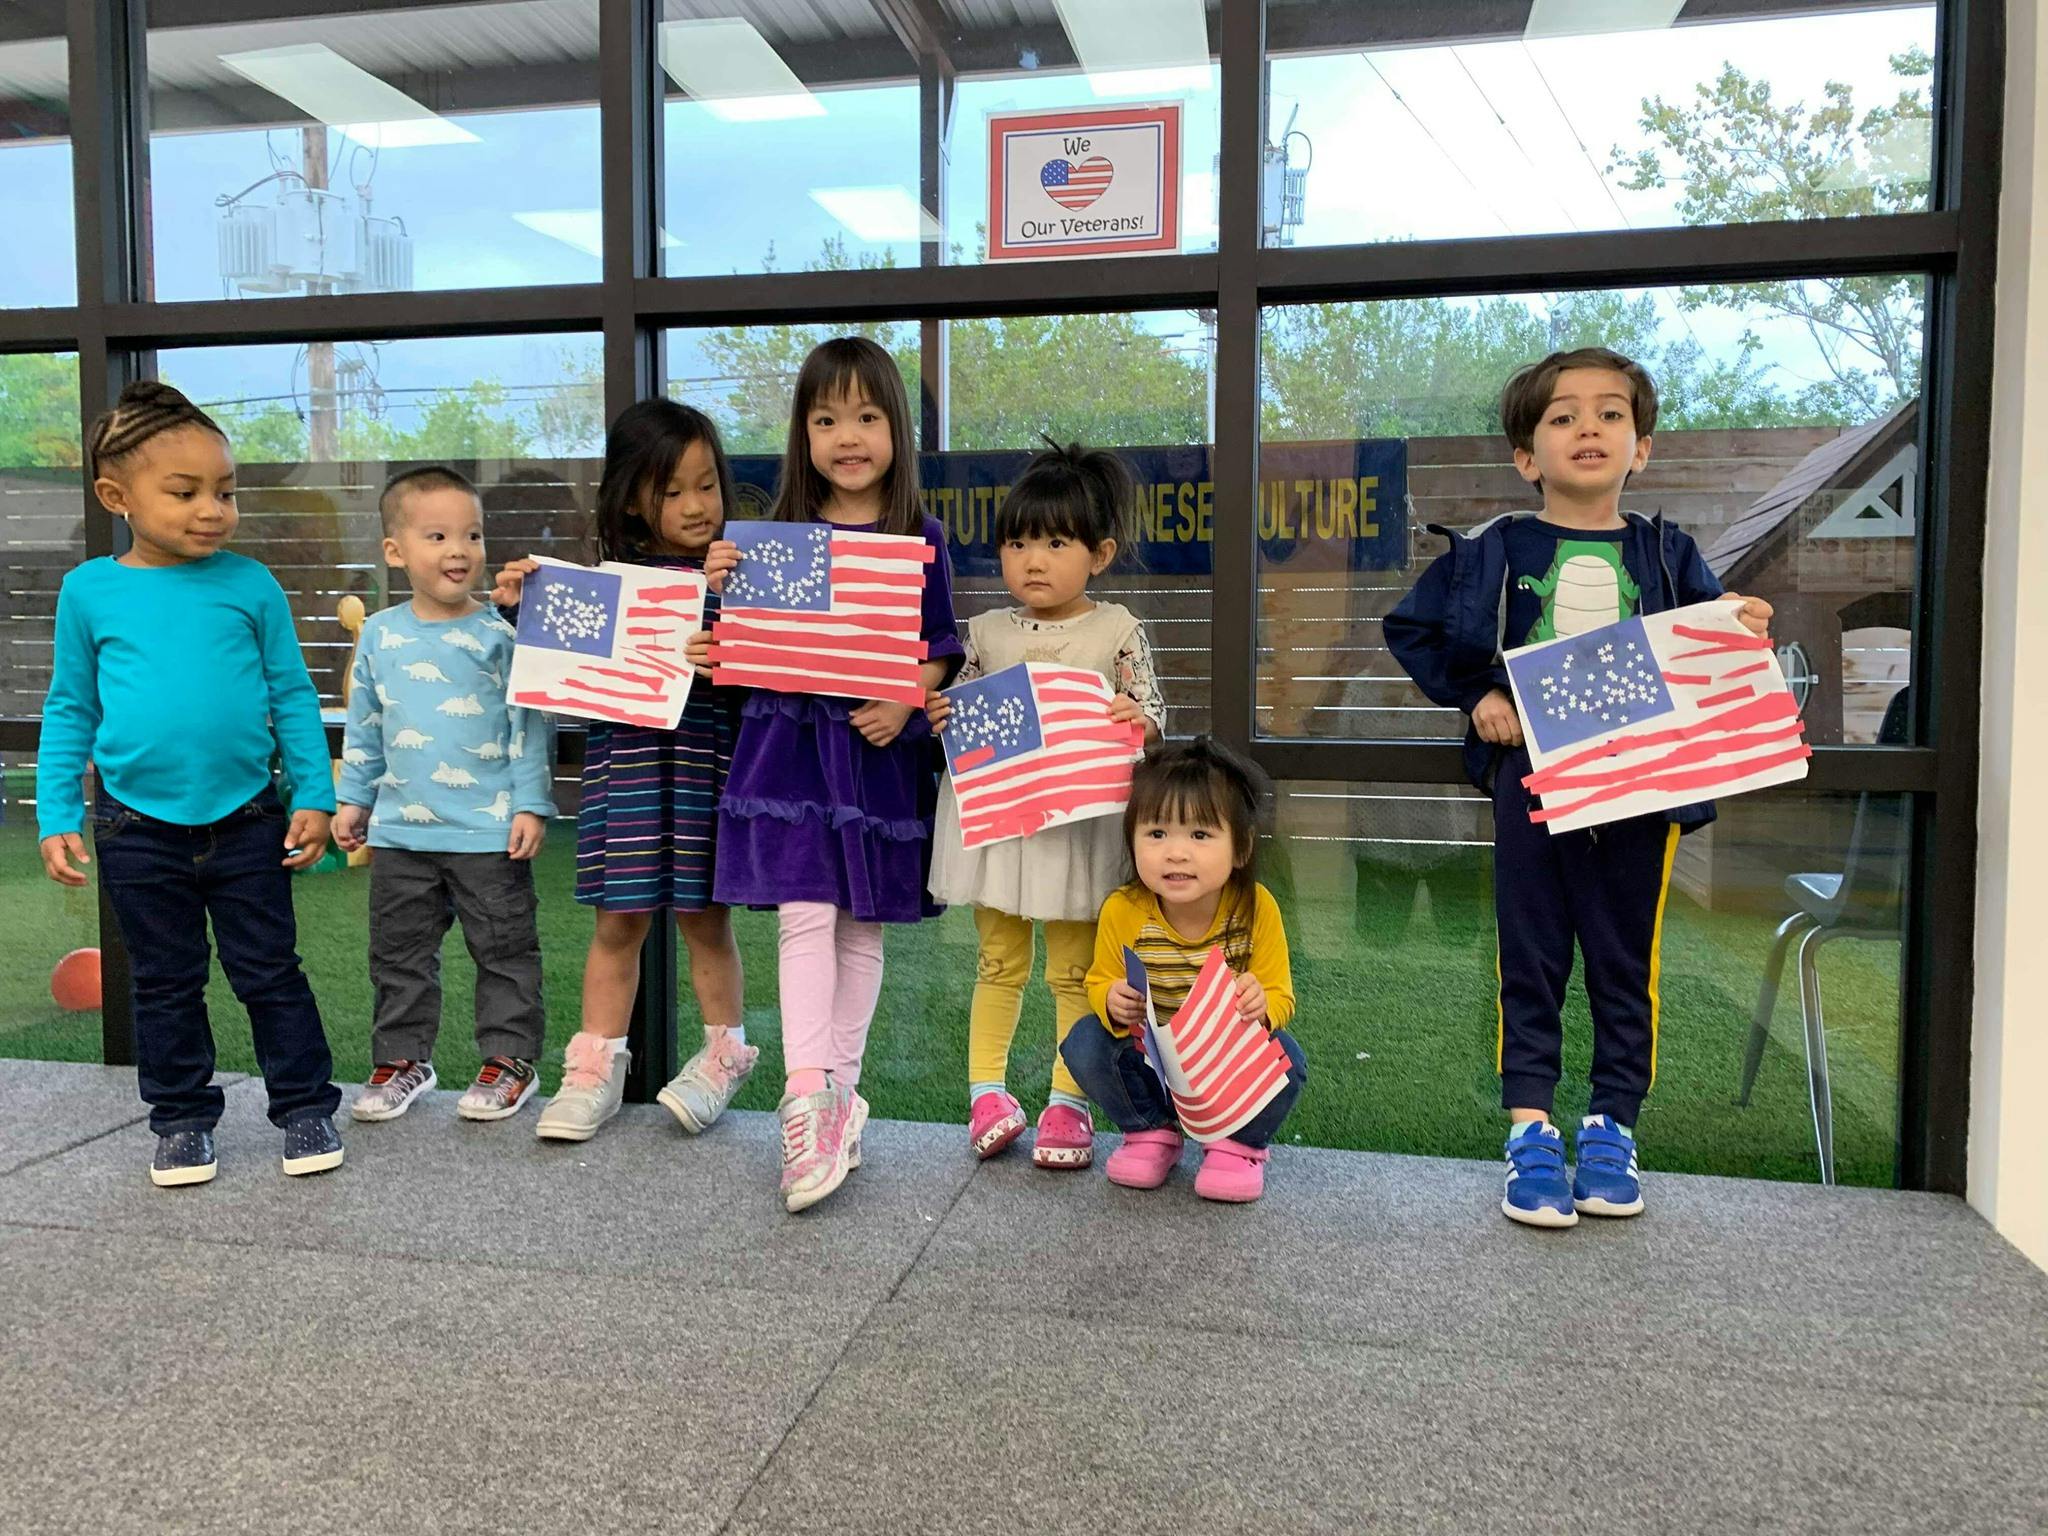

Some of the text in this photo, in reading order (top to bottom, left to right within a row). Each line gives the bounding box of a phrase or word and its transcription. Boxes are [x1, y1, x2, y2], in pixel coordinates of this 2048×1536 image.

[1063, 136, 1091, 156] We
[1021, 215, 1144, 239] Our Veterans!
[1132, 482, 1215, 543] NESE
[1258, 476, 1380, 541] ULTURE
